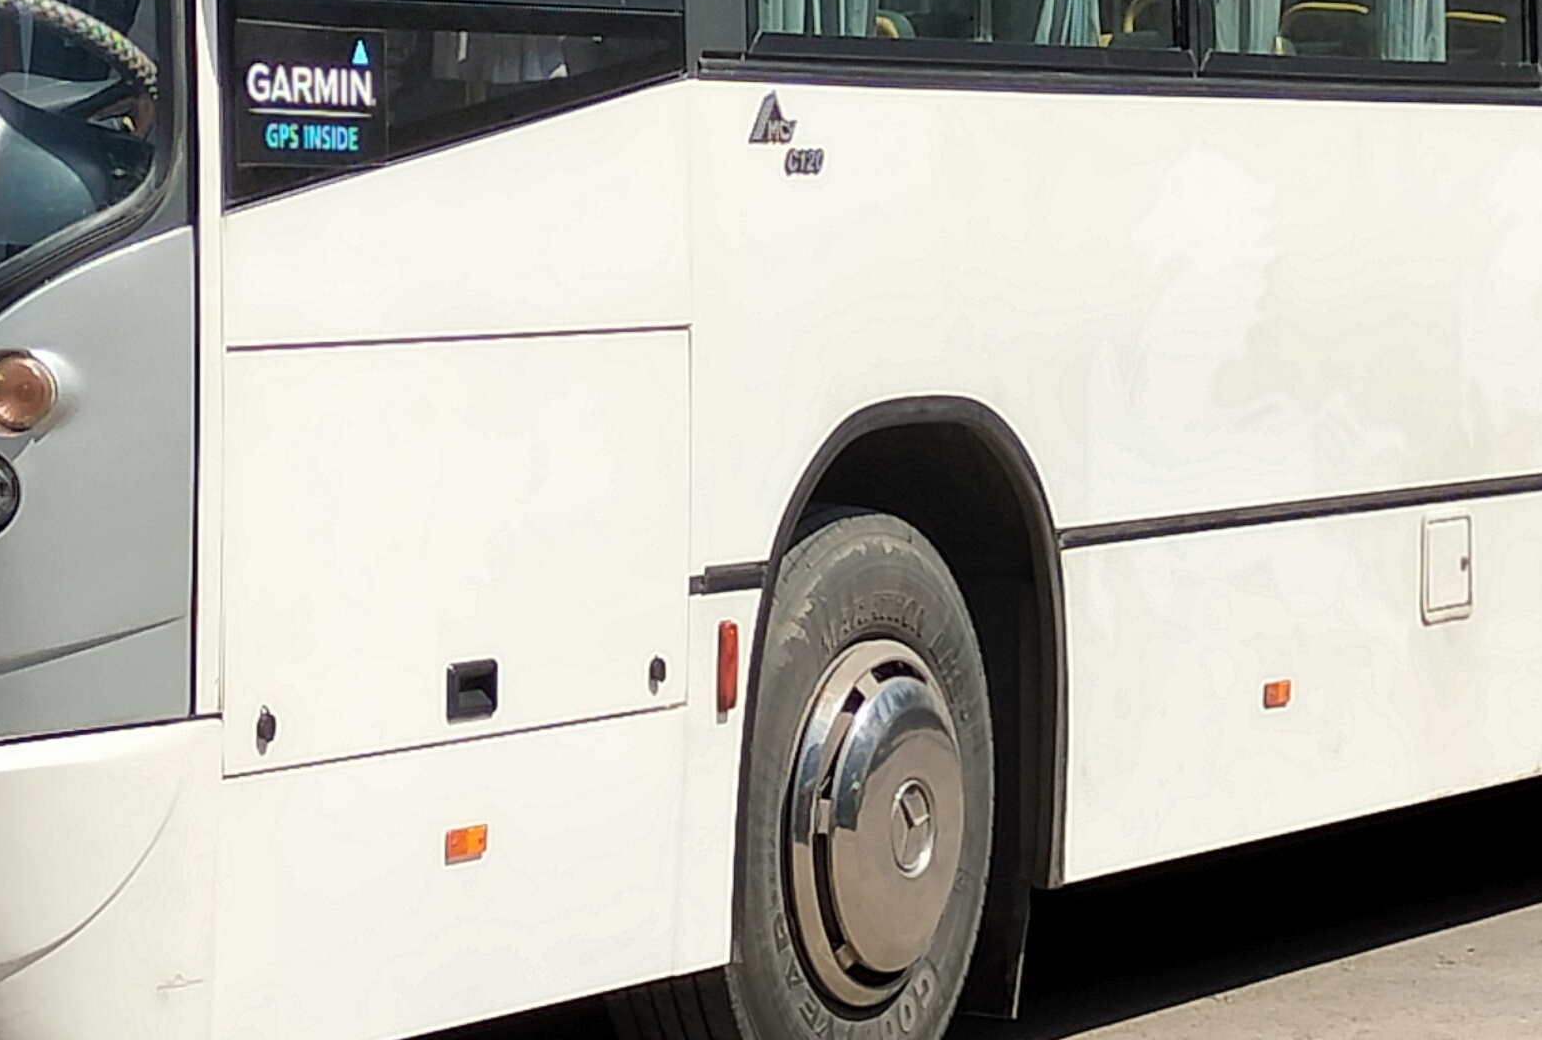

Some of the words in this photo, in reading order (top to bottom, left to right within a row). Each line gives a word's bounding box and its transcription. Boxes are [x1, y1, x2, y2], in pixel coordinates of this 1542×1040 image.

[246, 62, 374, 106] GARMIN
[265, 123, 299, 149] GPS
[303, 125, 359, 151] INSIDE
[784, 147, 825, 176] C120
